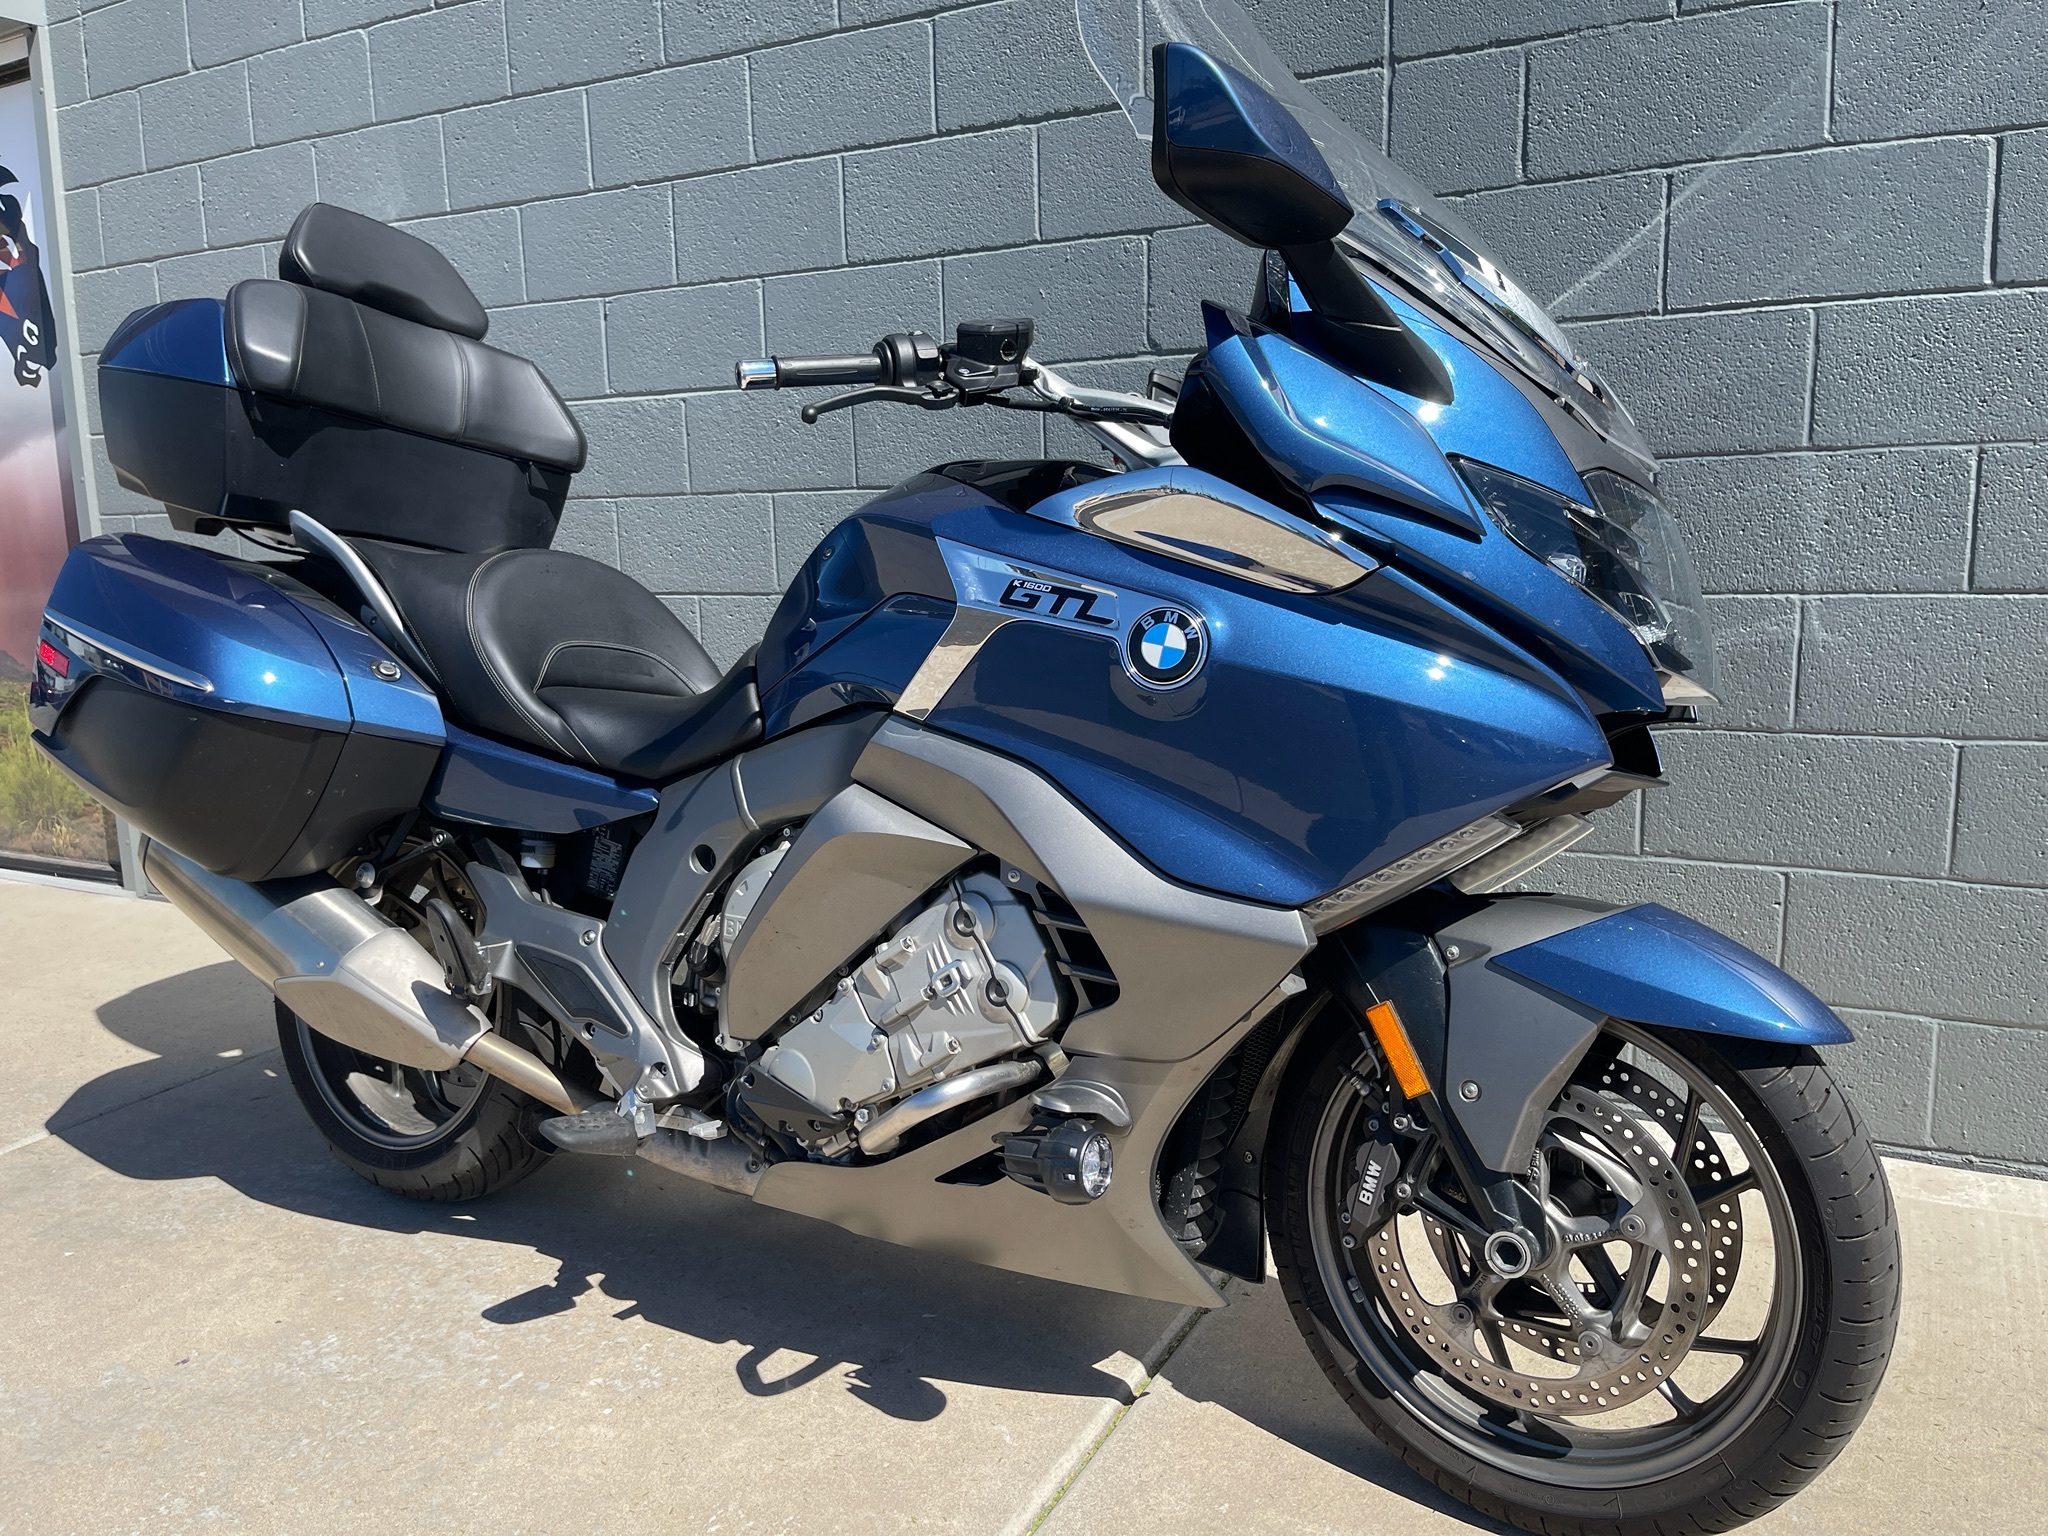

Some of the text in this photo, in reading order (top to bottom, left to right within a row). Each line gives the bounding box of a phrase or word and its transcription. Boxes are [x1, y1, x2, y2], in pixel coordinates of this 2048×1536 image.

[999, 579, 1115, 625] GTL
[1012, 579, 1053, 593] K 1600
[1140, 611, 1199, 640] BMW
[1358, 1159, 1382, 1206] BMW
